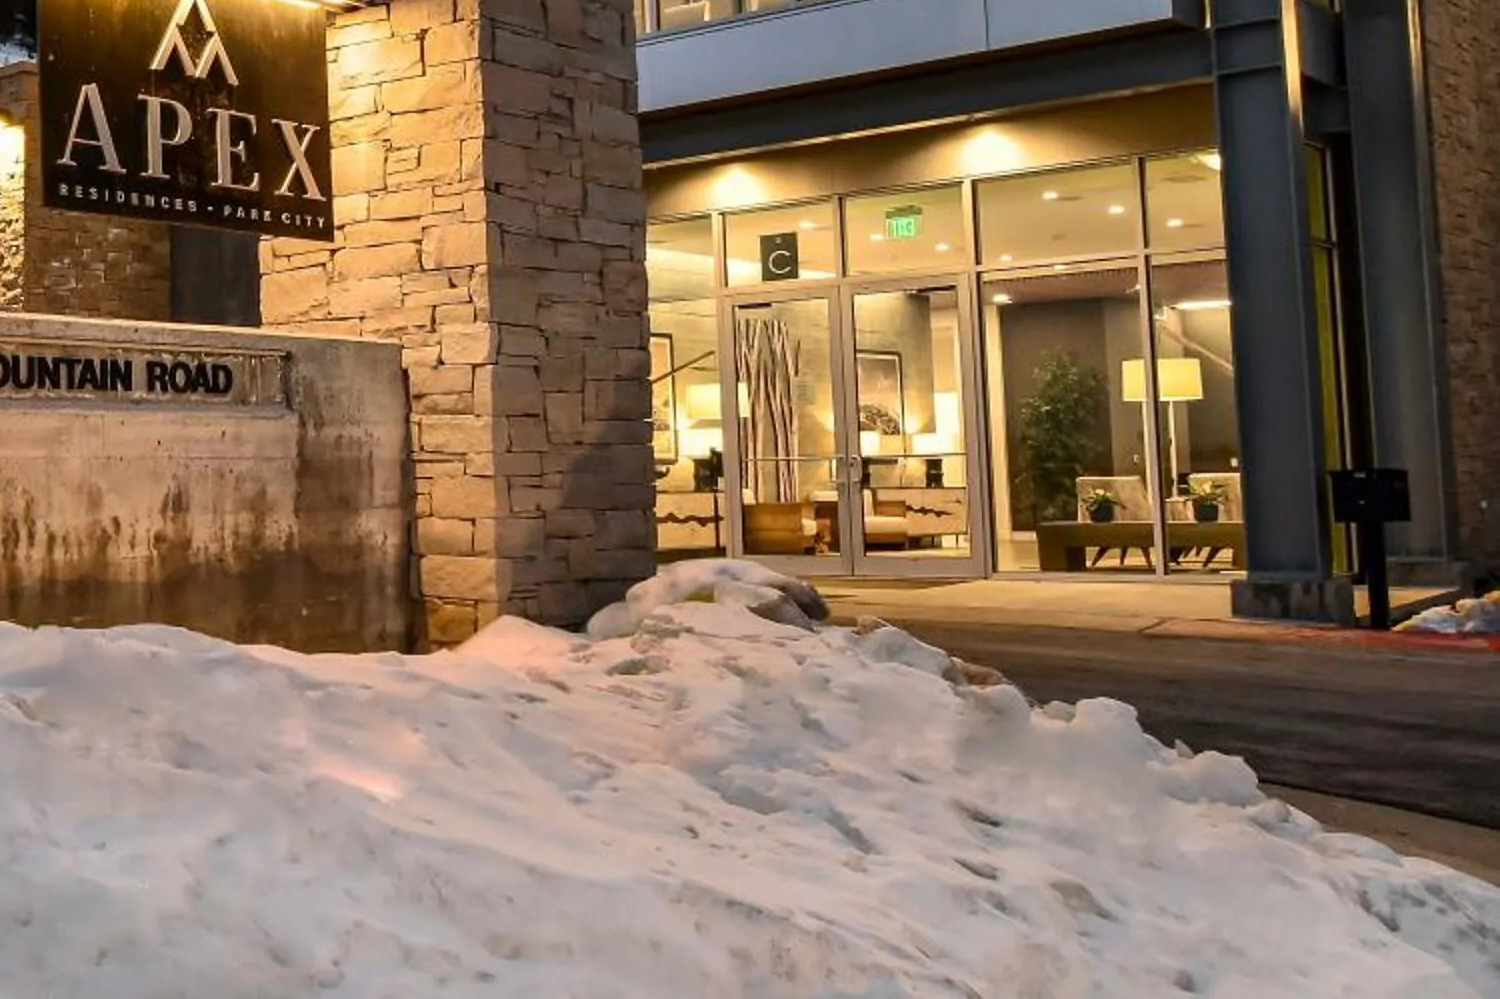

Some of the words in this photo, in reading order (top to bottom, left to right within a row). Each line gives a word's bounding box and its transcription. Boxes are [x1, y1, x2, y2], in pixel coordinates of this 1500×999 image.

[56, 82, 327, 202] APEX
[59, 183, 197, 212] RESIDENCES
[223, 204, 272, 222] PARK
[281, 212, 325, 229] CITY
[768, 250, 792, 274] C
[145, 361, 233, 394] ROAD
